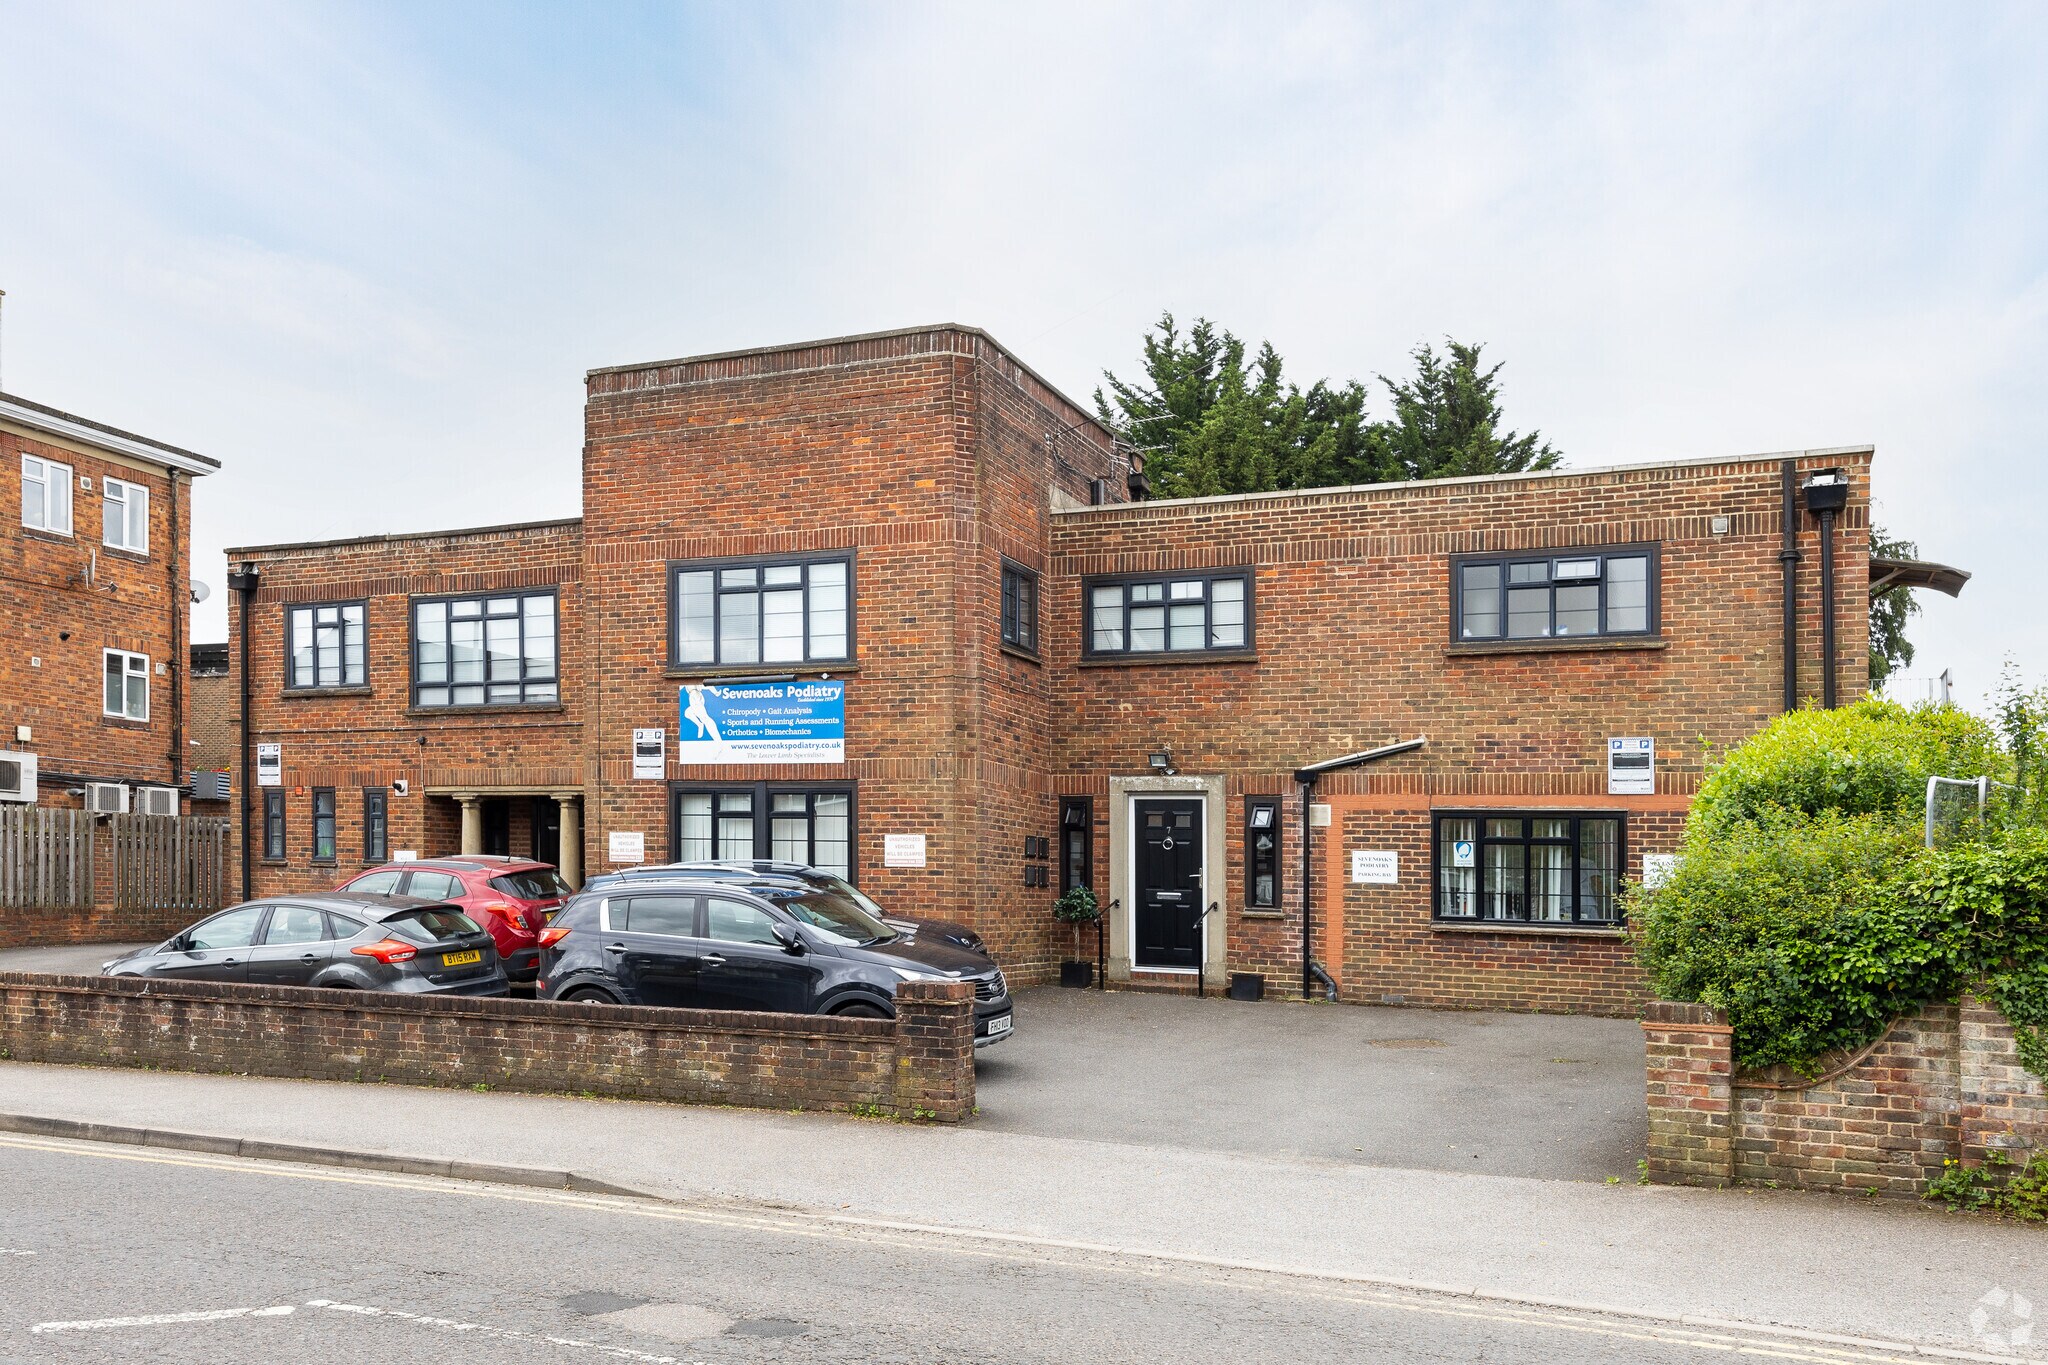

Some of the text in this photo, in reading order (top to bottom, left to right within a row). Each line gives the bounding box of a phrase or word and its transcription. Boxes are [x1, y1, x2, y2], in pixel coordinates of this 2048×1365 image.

[722, 685, 842, 699] Sevenoaks Podiatry
[727, 708, 761, 716] Chiropody
[783, 707, 812, 715] Analysis
[727, 719, 749, 727] Sports
[765, 718, 794, 727] Running
[795, 717, 840, 725] Assessments
[764, 728, 811, 736] Biomechanics
[731, 741, 841, 751] www.sevenoakspodiatry.co.uk
[1166, 826, 1171, 834] 7
[447, 952, 464, 964] BT15
